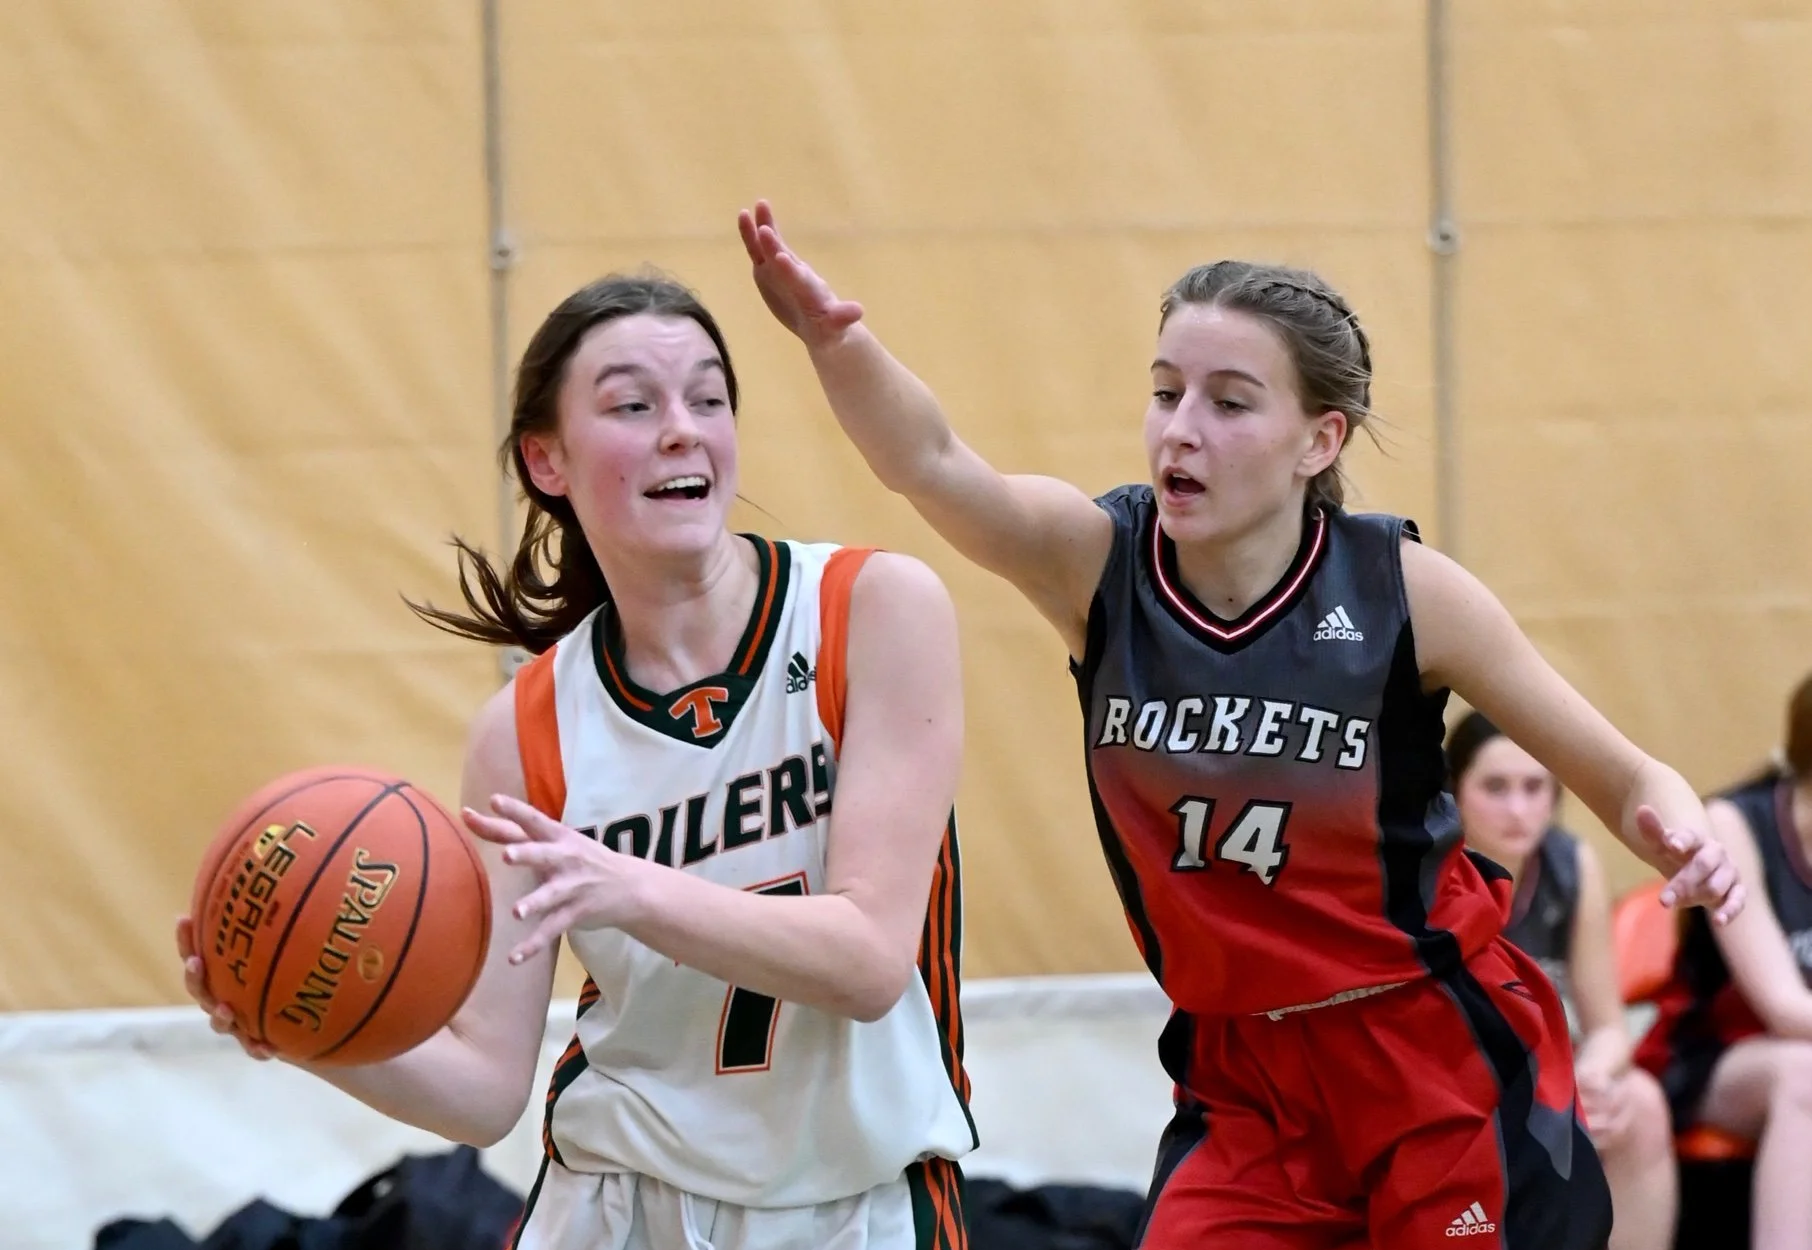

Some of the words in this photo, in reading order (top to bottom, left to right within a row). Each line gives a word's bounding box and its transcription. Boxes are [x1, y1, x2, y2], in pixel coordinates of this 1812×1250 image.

[1313, 626, 1364, 641] adidas
[668, 686, 729, 738] T
[1094, 694, 1373, 770] ROCKETS
[576, 741, 833, 869] OILERS
[1169, 795, 1292, 887] 14
[226, 819, 320, 988] LEGACY
[277, 847, 400, 1033] SPALDING
[1445, 1221, 1496, 1237] adidas
